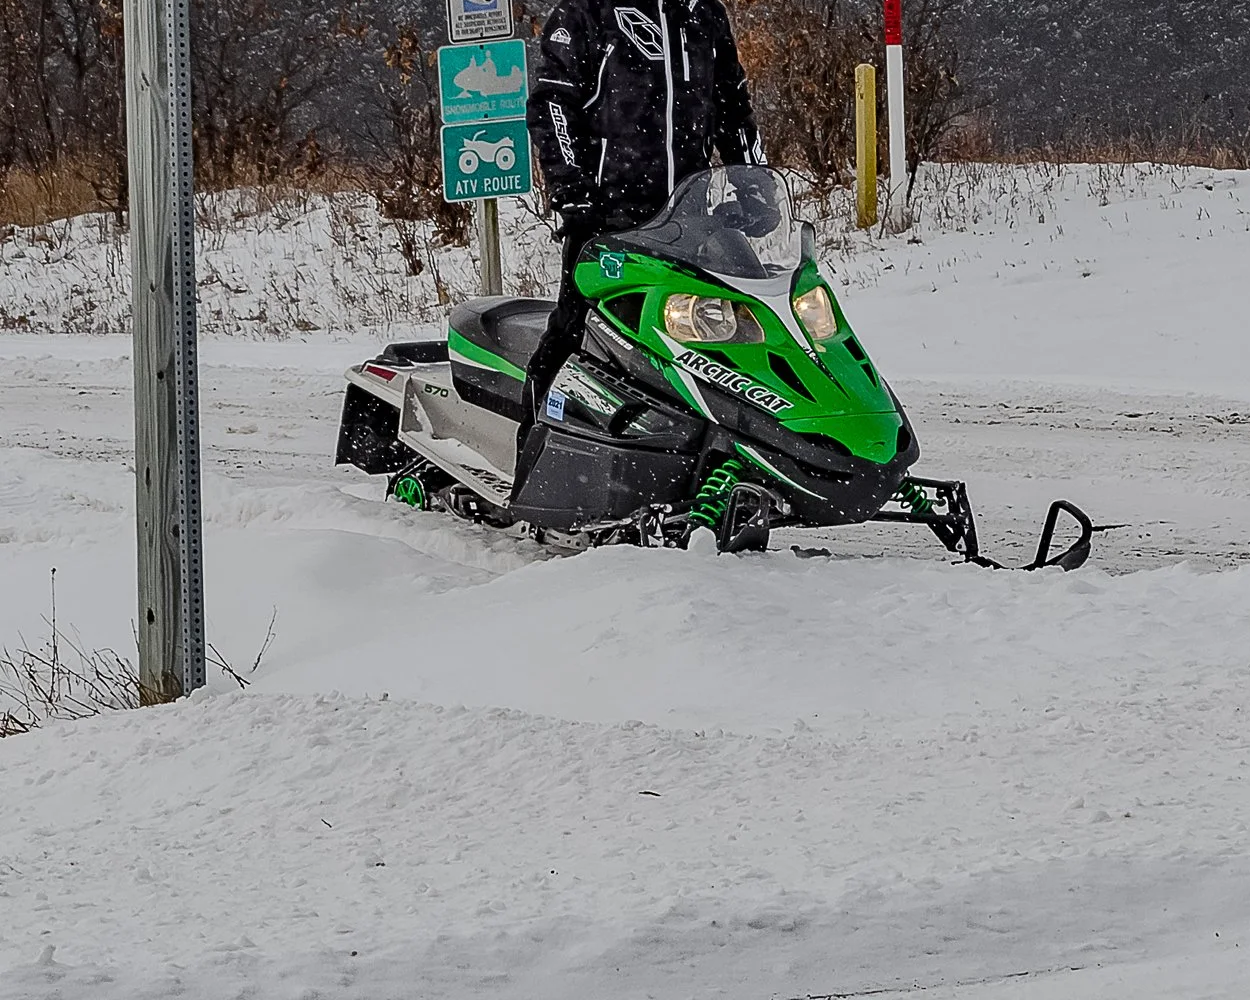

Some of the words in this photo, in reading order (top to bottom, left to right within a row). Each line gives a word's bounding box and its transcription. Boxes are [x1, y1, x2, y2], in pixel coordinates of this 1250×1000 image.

[444, 100, 496, 115] SNOWMOBILE
[500, 96, 526, 109] ROUTE
[455, 179, 478, 195] ATV
[484, 175, 522, 193] ROUTE
[598, 322, 634, 351] SERIES
[424, 383, 449, 398] 570
[674, 349, 751, 393] ARCTIC
[745, 386, 795, 413] CAT
[548, 397, 563, 410] 2021
